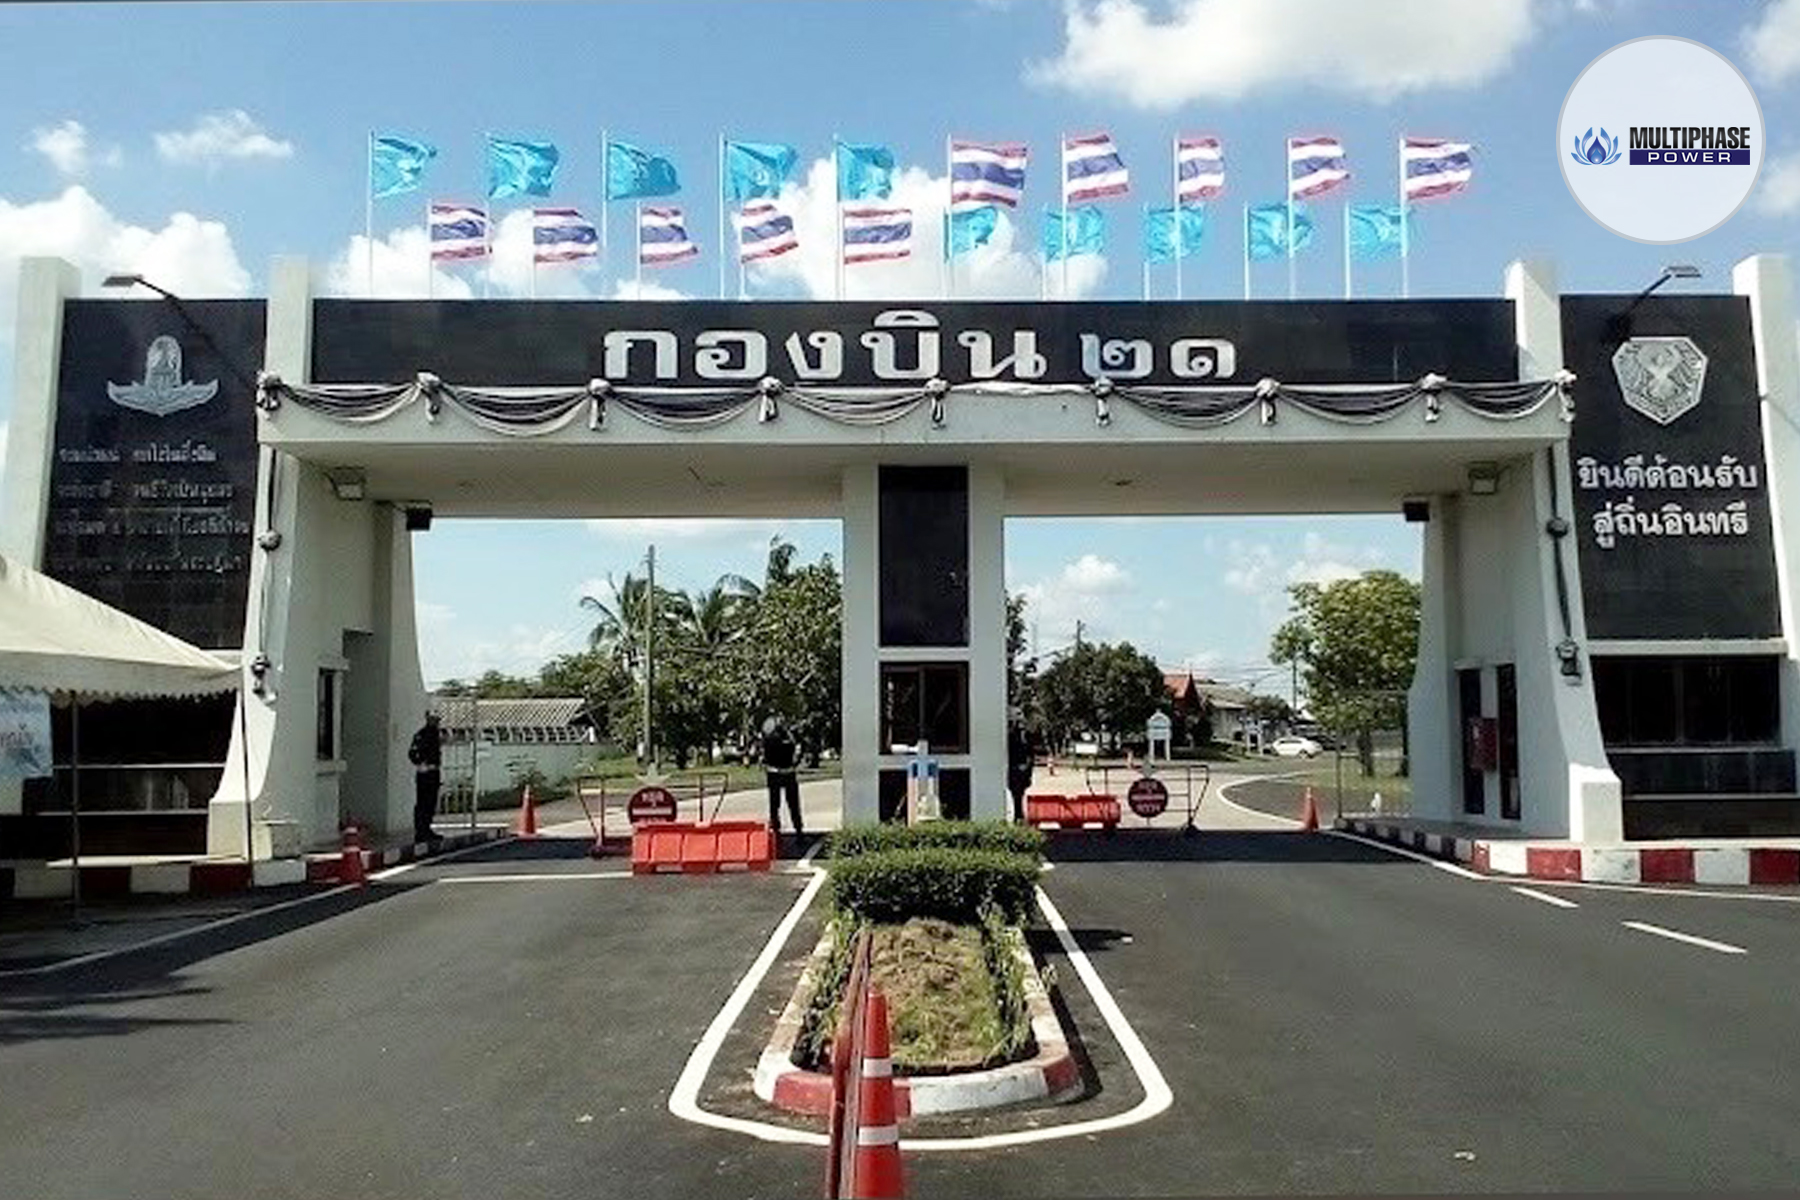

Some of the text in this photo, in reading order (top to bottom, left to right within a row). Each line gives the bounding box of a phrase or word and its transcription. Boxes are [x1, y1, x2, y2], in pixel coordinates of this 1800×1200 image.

[603, 309, 1236, 379] กองบิน ๒๑
[1576, 454, 1758, 488] ยินดีต้อนรับ
[1592, 496, 1749, 548] สู่ถิ่นอินทรี
